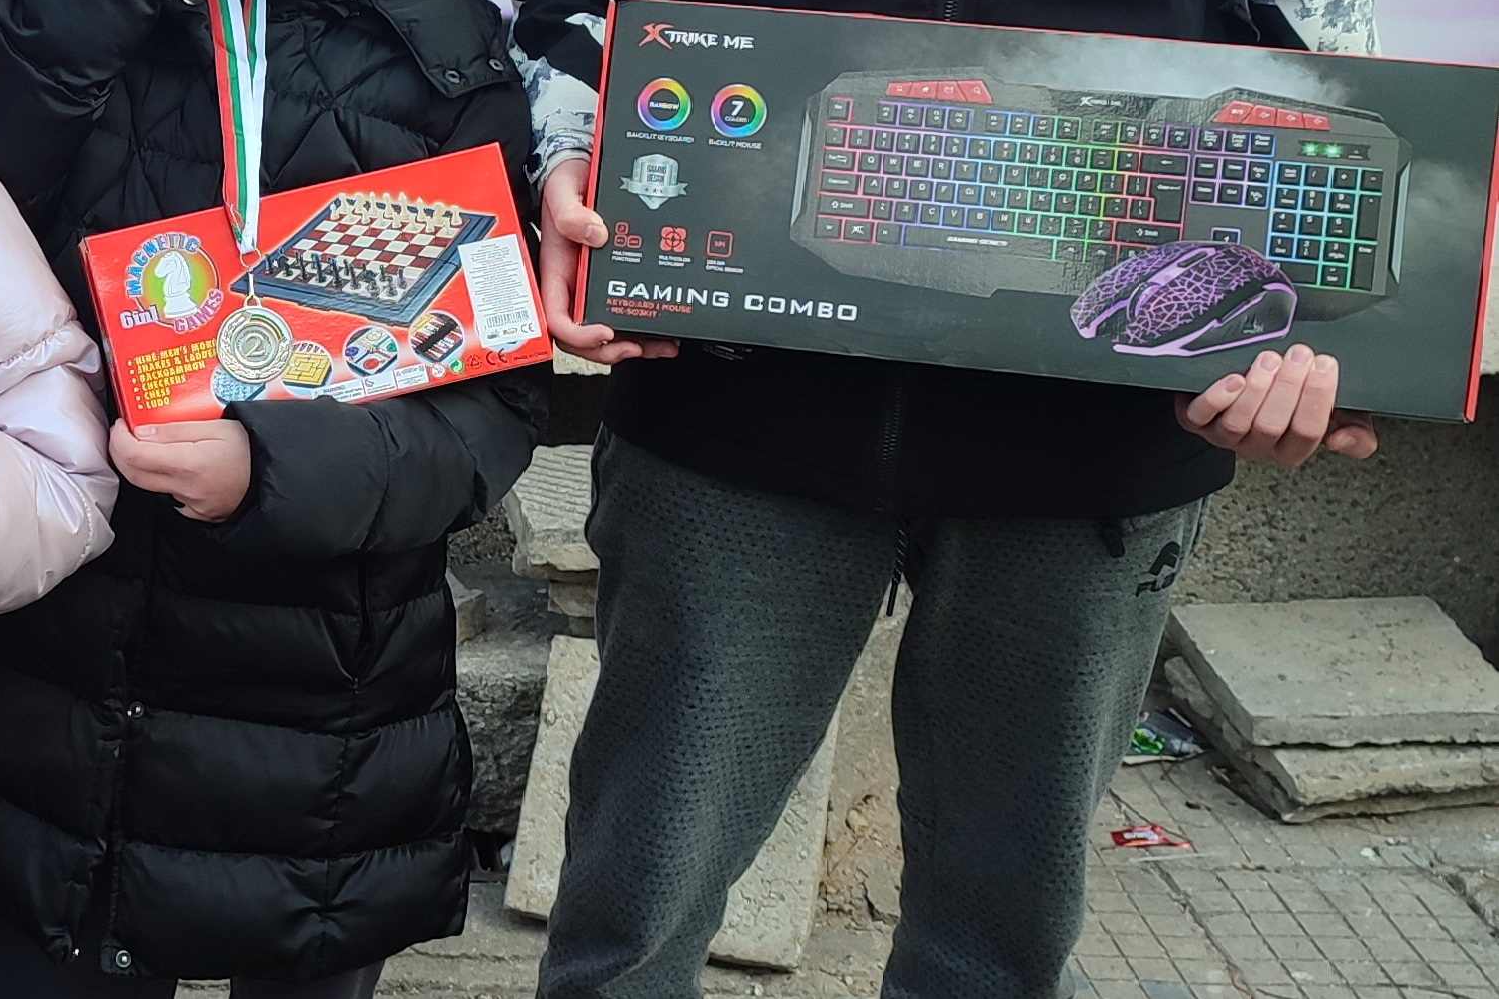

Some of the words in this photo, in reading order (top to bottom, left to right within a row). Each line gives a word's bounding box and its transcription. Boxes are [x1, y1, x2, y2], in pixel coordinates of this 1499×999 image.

[638, 23, 718, 49] XTRIKE
[722, 34, 755, 50] ME
[731, 100, 745, 116] 7
[124, 232, 202, 299] MAGNETIC
[172, 288, 224, 334] GAMES
[607, 280, 731, 308] GAMING
[744, 293, 858, 322] COMBO
[661, 303, 693, 314] MOUSE
[245, 332, 266, 358] 2
[139, 360, 206, 382] BACKGAMMON
[141, 373, 187, 391] CHECKERS
[144, 386, 170, 400] CHESS
[145, 396, 170, 410] LUDO
